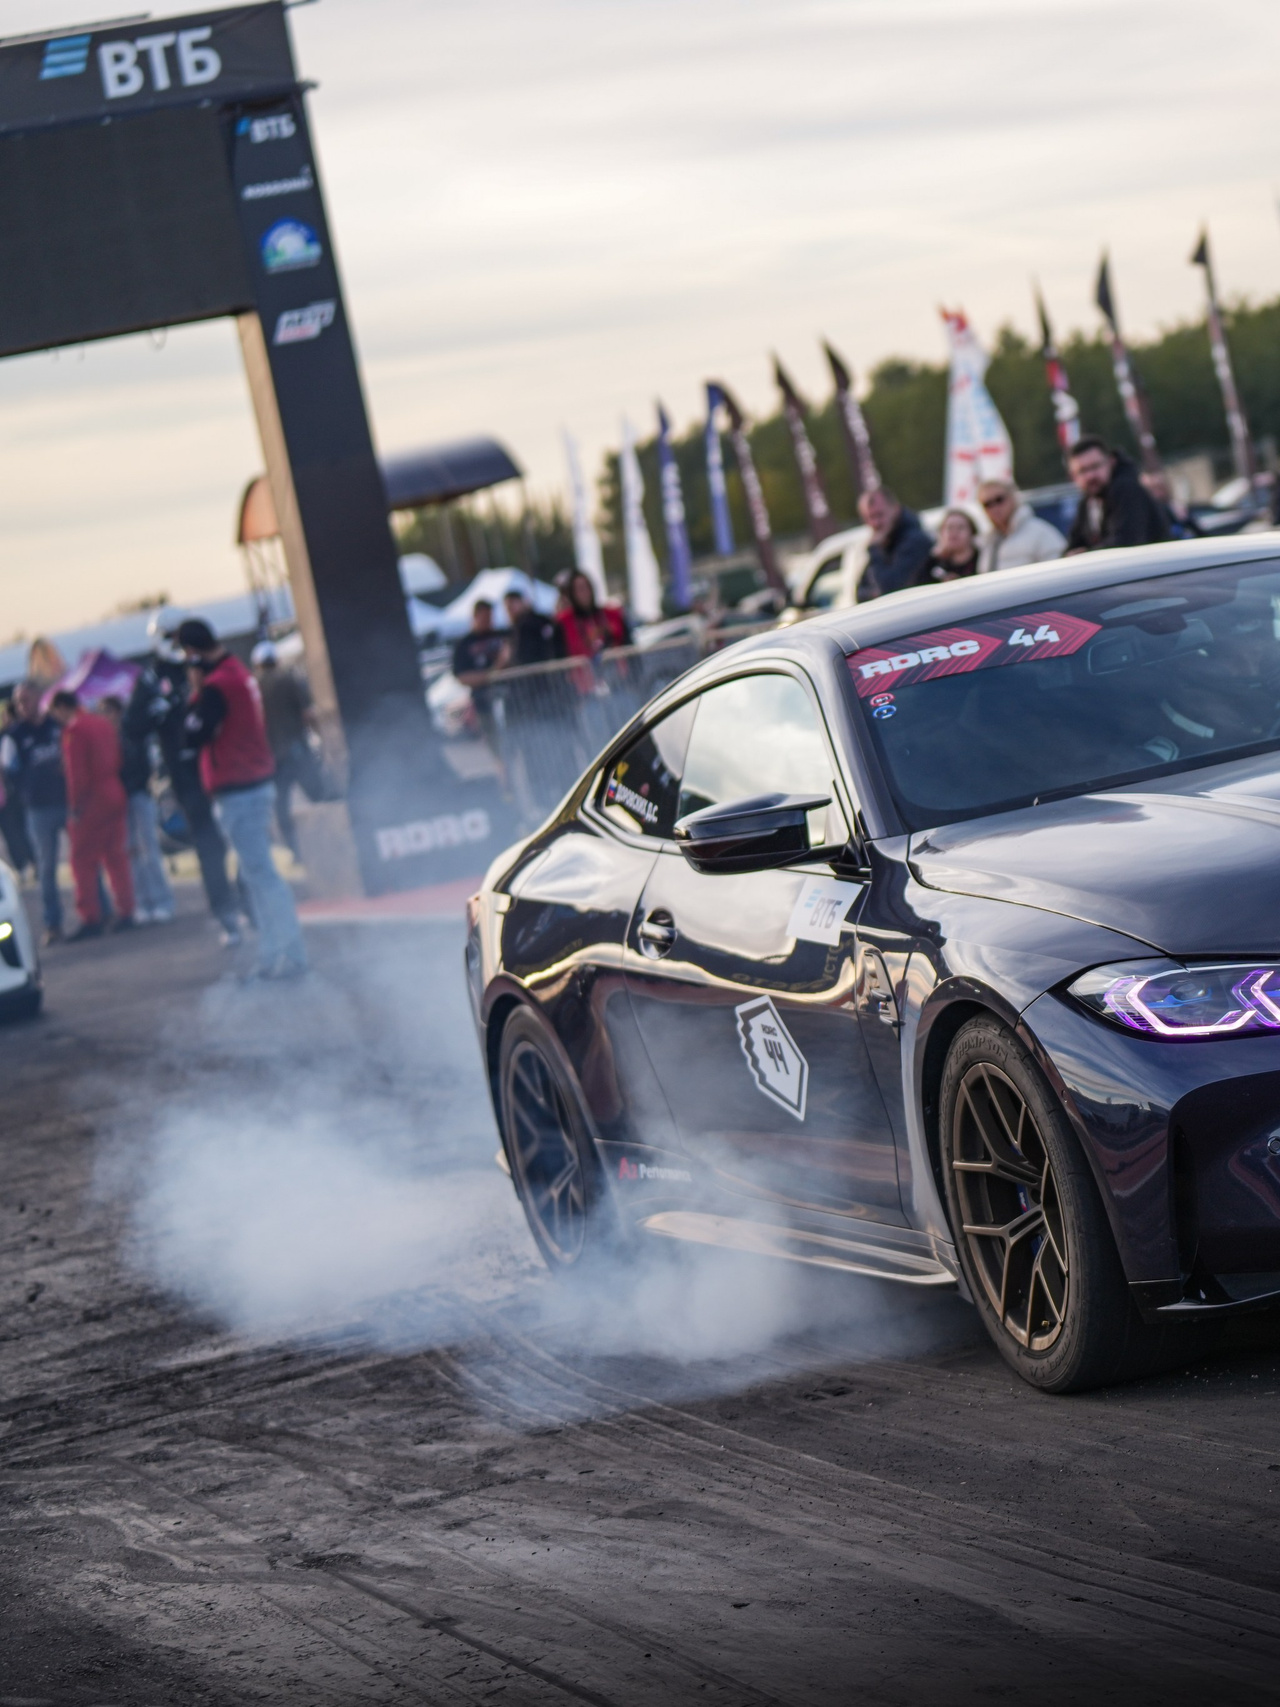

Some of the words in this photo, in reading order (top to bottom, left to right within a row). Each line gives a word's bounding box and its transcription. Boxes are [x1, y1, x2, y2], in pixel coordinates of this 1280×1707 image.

[98, 26, 221, 99] ВТБ
[250, 114, 296, 143] ВТБ
[858, 640, 980, 679] RDRC
[1008, 625, 1060, 647] 44
[809, 897, 843, 929] ВТБ
[763, 1038, 790, 1075] 44
